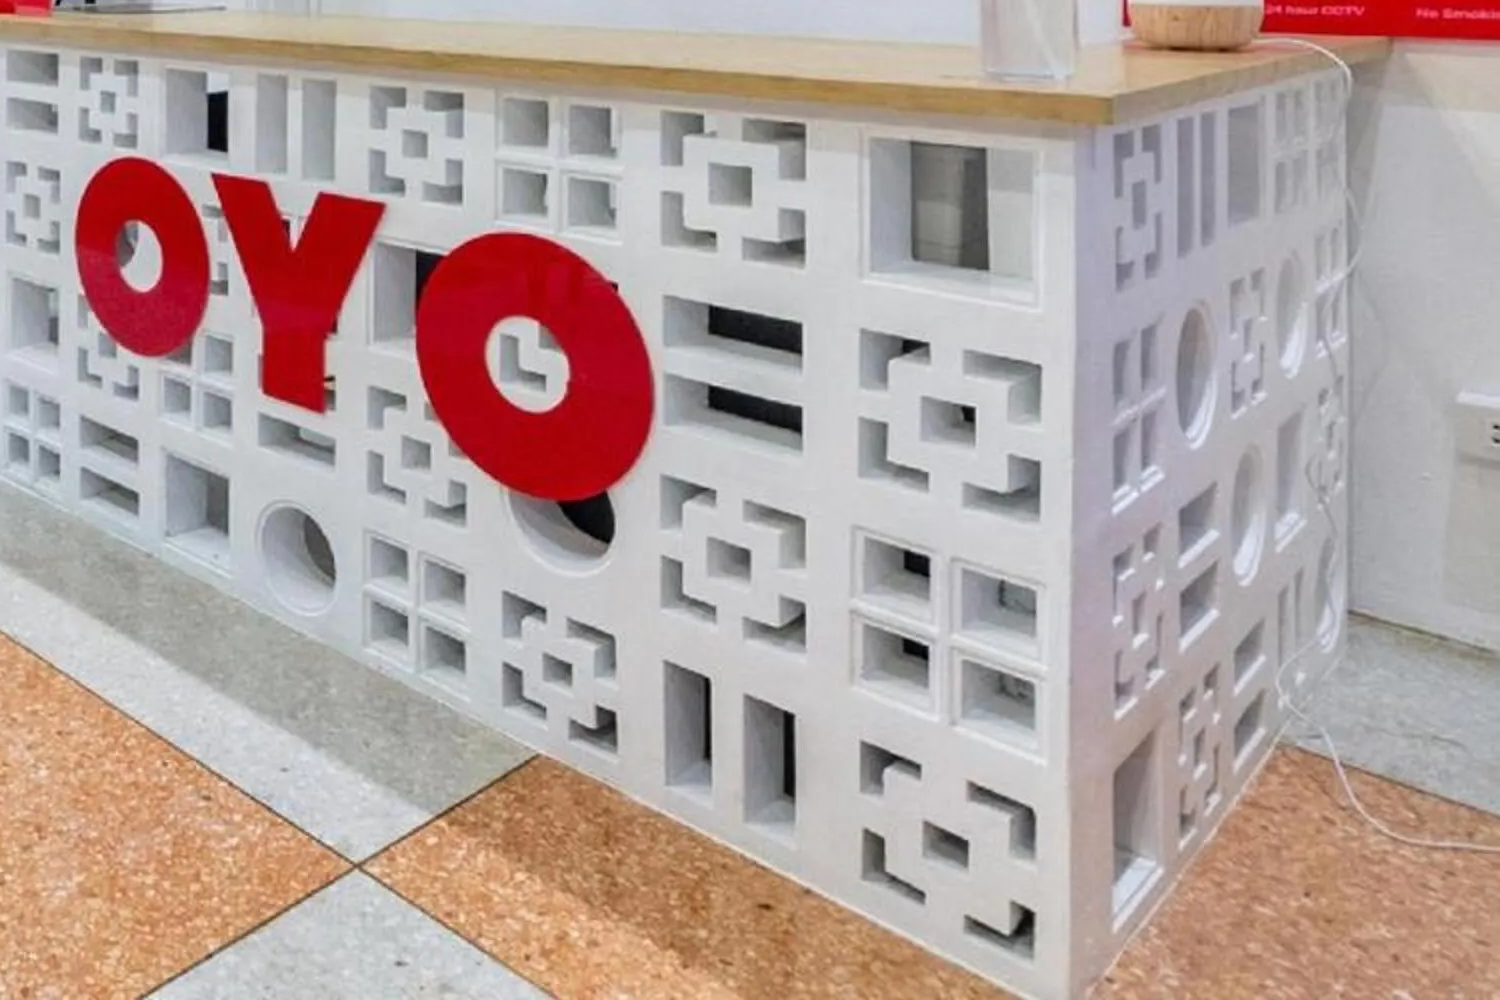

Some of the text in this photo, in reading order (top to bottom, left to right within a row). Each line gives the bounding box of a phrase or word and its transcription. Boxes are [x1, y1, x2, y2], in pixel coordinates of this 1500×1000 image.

[1321, 5, 1365, 16] CCTV
[1416, 7, 1439, 18] No
[75, 156, 655, 501] OYO
